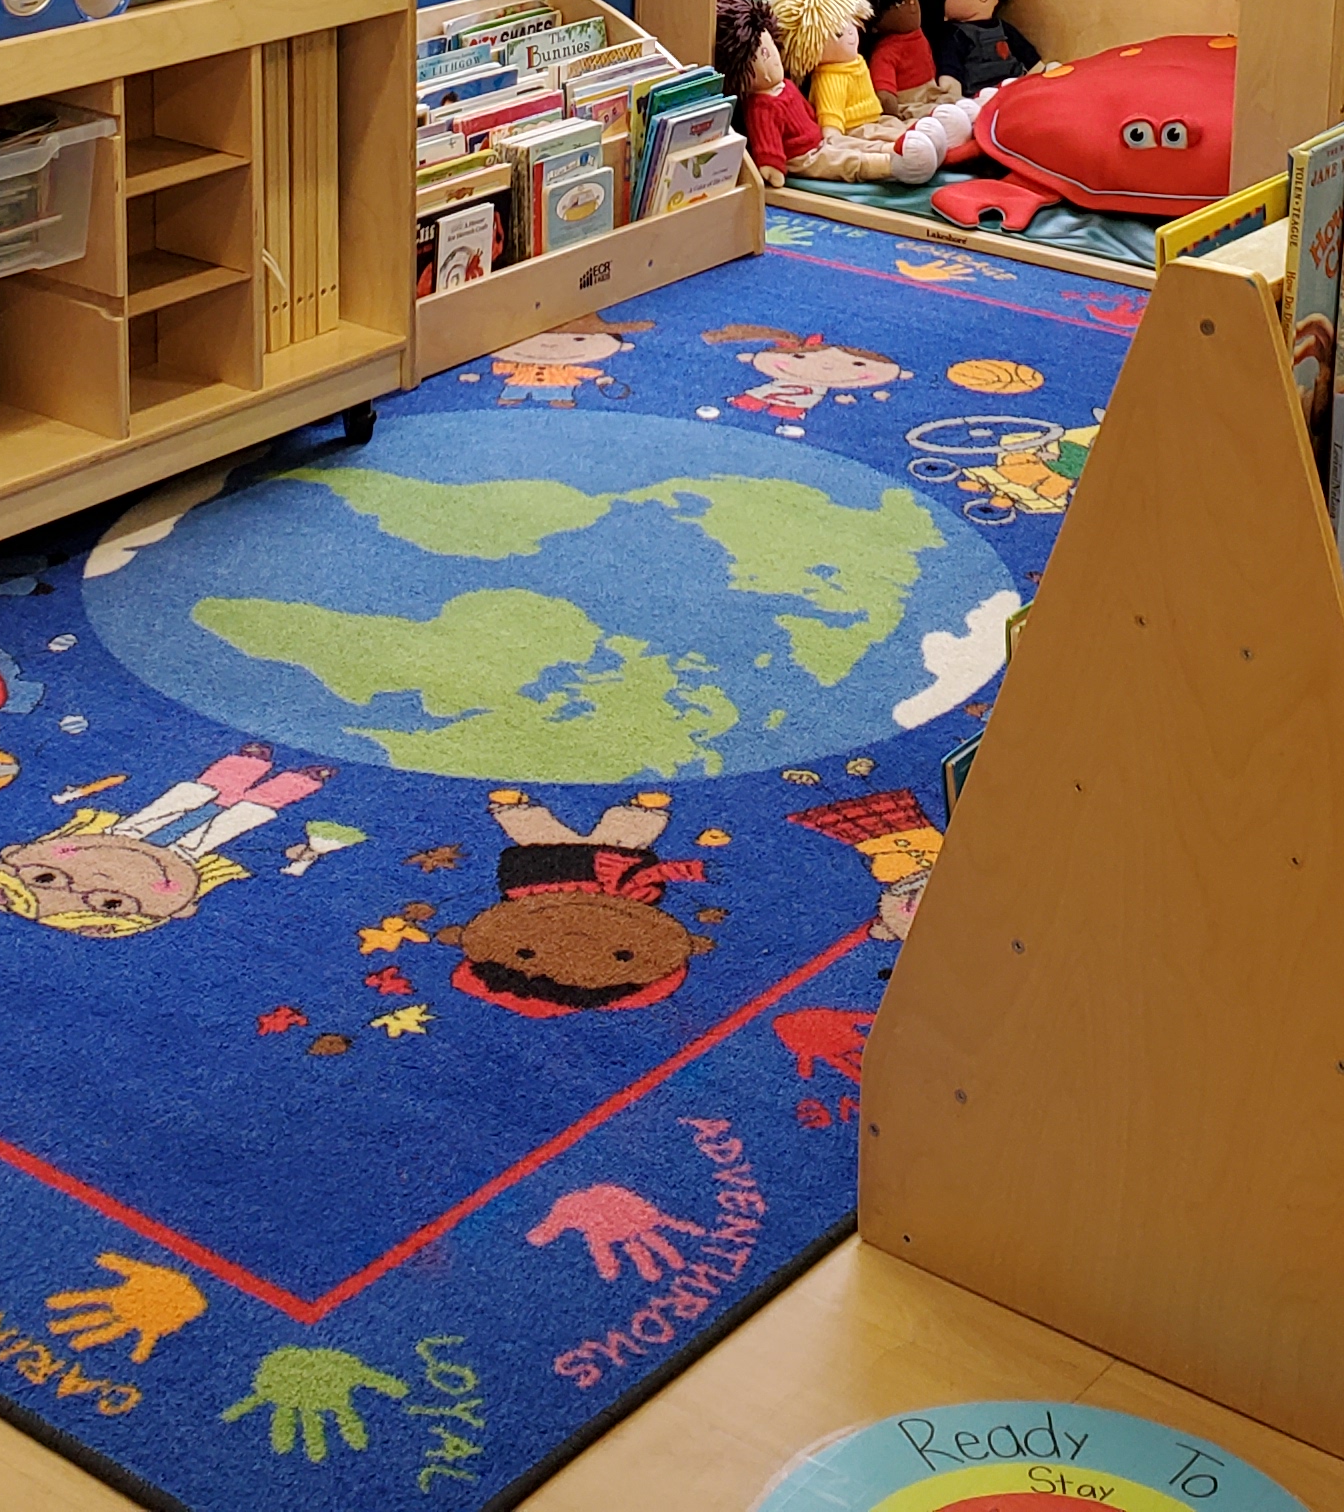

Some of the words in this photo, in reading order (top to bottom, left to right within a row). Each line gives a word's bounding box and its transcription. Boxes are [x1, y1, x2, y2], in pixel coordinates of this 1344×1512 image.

[526, 39, 590, 70] Bunnies
[549, 31, 566, 45] The
[432, 56, 481, 77] LITHGOW
[1296, 166, 1305, 200] YOLEN
[1311, 160, 1338, 187] JANE
[1289, 204, 1303, 248] TEAGUE
[1287, 270, 1296, 292] How
[551, 1112, 770, 1392] ADVENTUROUS
[413, 1334, 489, 1495] LOYAL
[897, 1410, 1089, 1471] Ready
[1167, 1442, 1225, 1500] To
[1027, 1464, 1116, 1502] Stay
